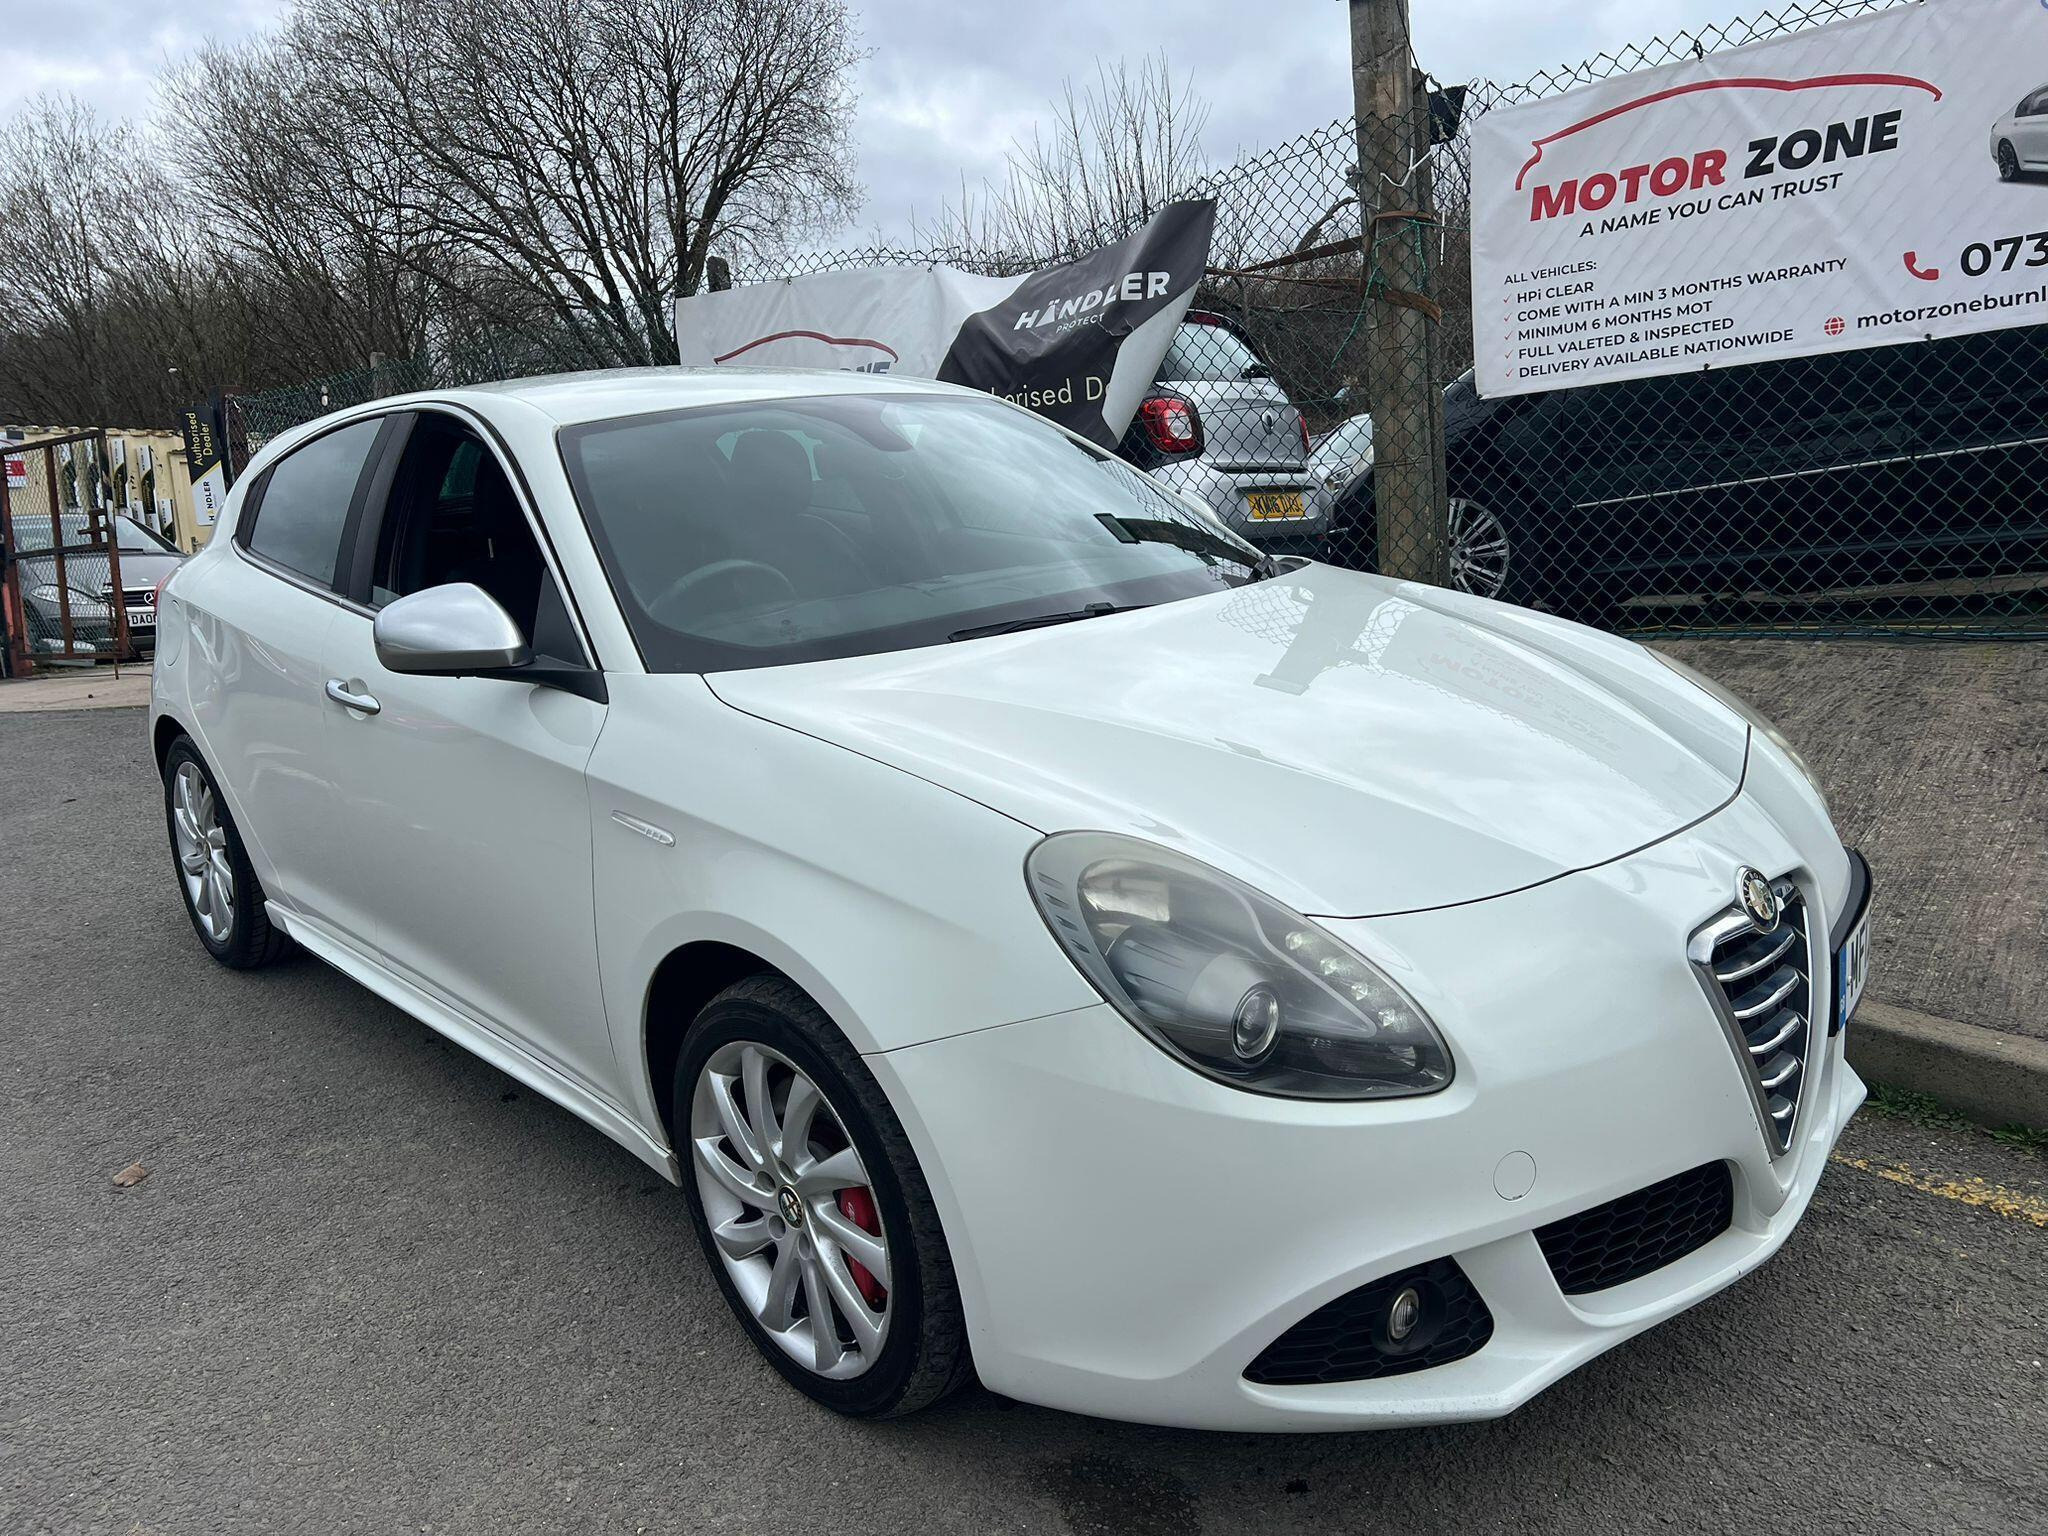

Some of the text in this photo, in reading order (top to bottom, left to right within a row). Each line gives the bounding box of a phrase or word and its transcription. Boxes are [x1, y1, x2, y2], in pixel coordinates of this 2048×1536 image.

[1529, 109, 1902, 222] MOTOR ZONE
[1579, 172, 1844, 238] A NAME YOU CAN TRUST
[1504, 260, 1597, 285] ALL VEHICLES:
[1517, 258, 1847, 322] COME WITH A MIN 3 MONTHS WARRANTY
[1517, 281, 1594, 304] HPi CLEAR
[1056, 312, 1105, 334] PROTECT
[1518, 301, 1713, 341] MINIMUM 6 MONTHS MOT
[1857, 285, 2047, 328] motorzoneburnl
[1519, 318, 1734, 359] FULL VALETED & INSPECTED
[1519, 329, 1793, 378] DELIVERY AVAILABLE NATIONWIDE
[186, 412, 204, 466] Authorised
[200, 422, 213, 456] Dealer
